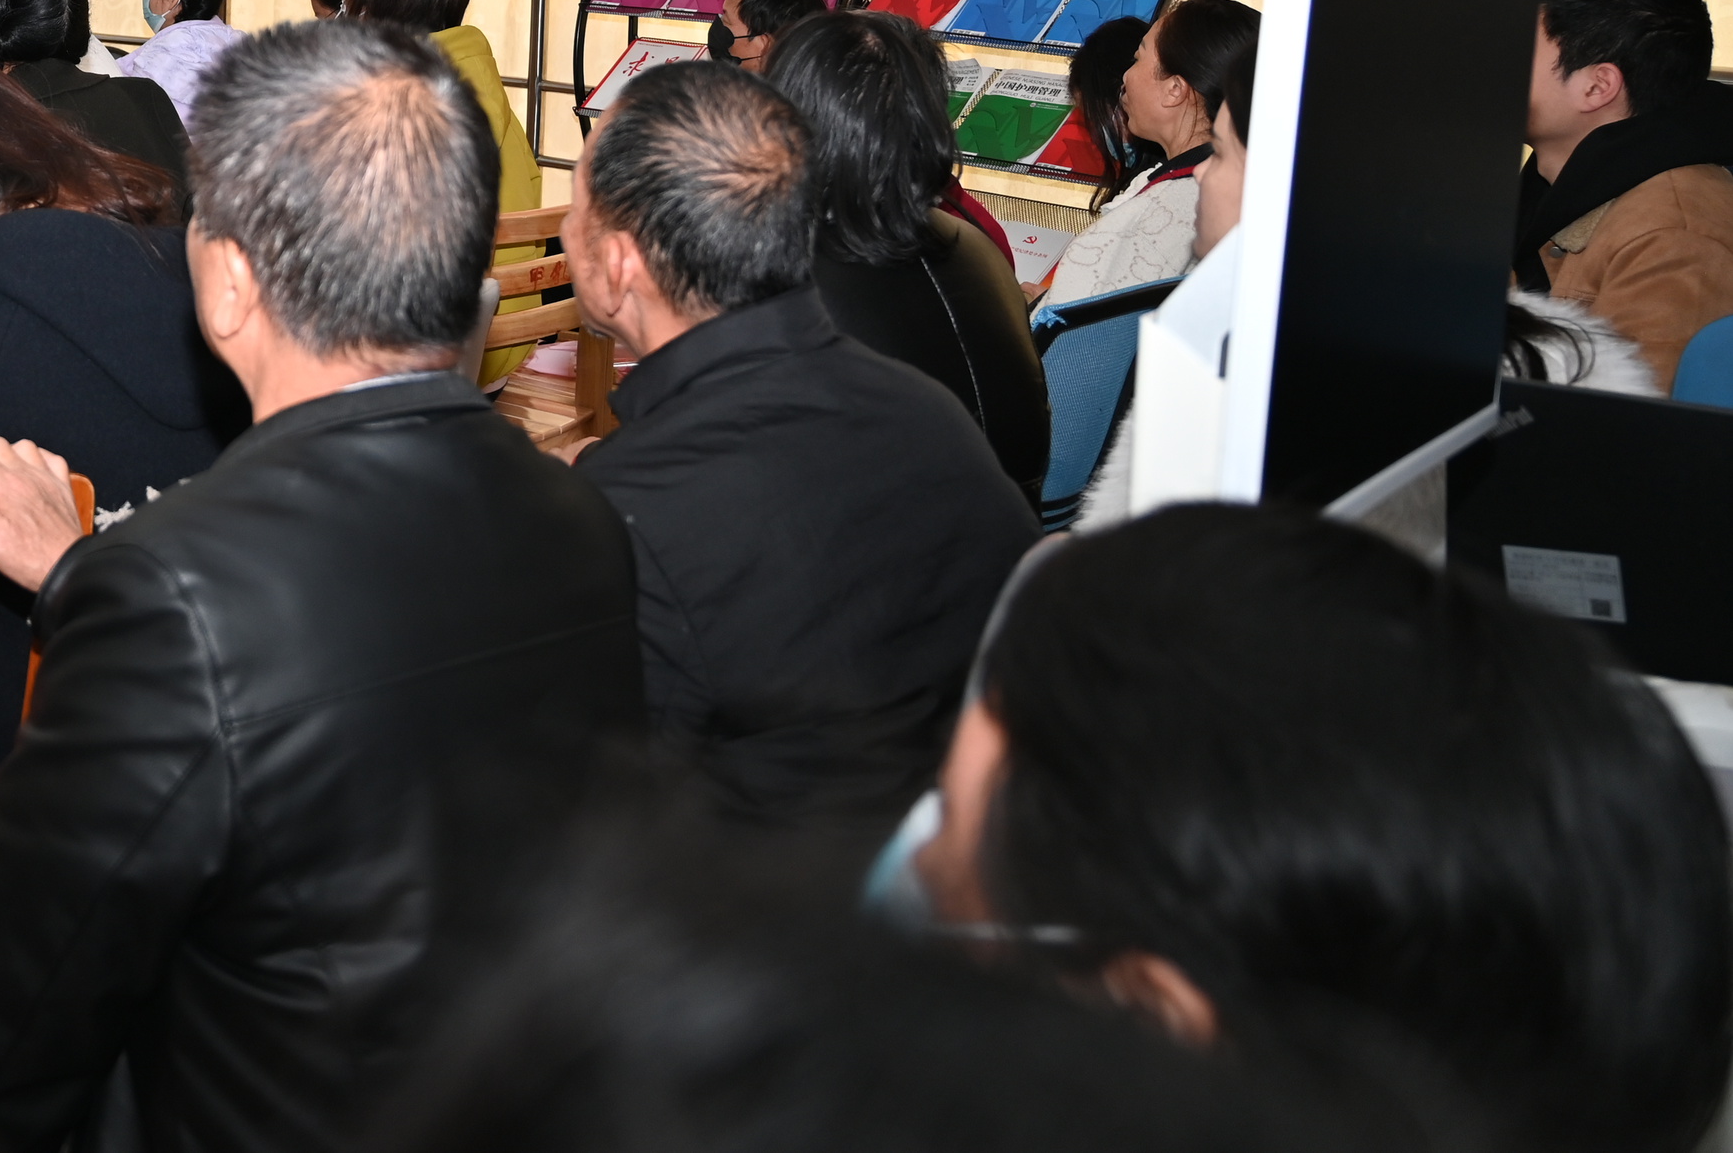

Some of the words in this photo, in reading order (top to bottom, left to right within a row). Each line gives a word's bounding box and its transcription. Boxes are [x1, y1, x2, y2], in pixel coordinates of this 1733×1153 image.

[994, 81, 1062, 97] 中国护理管理
